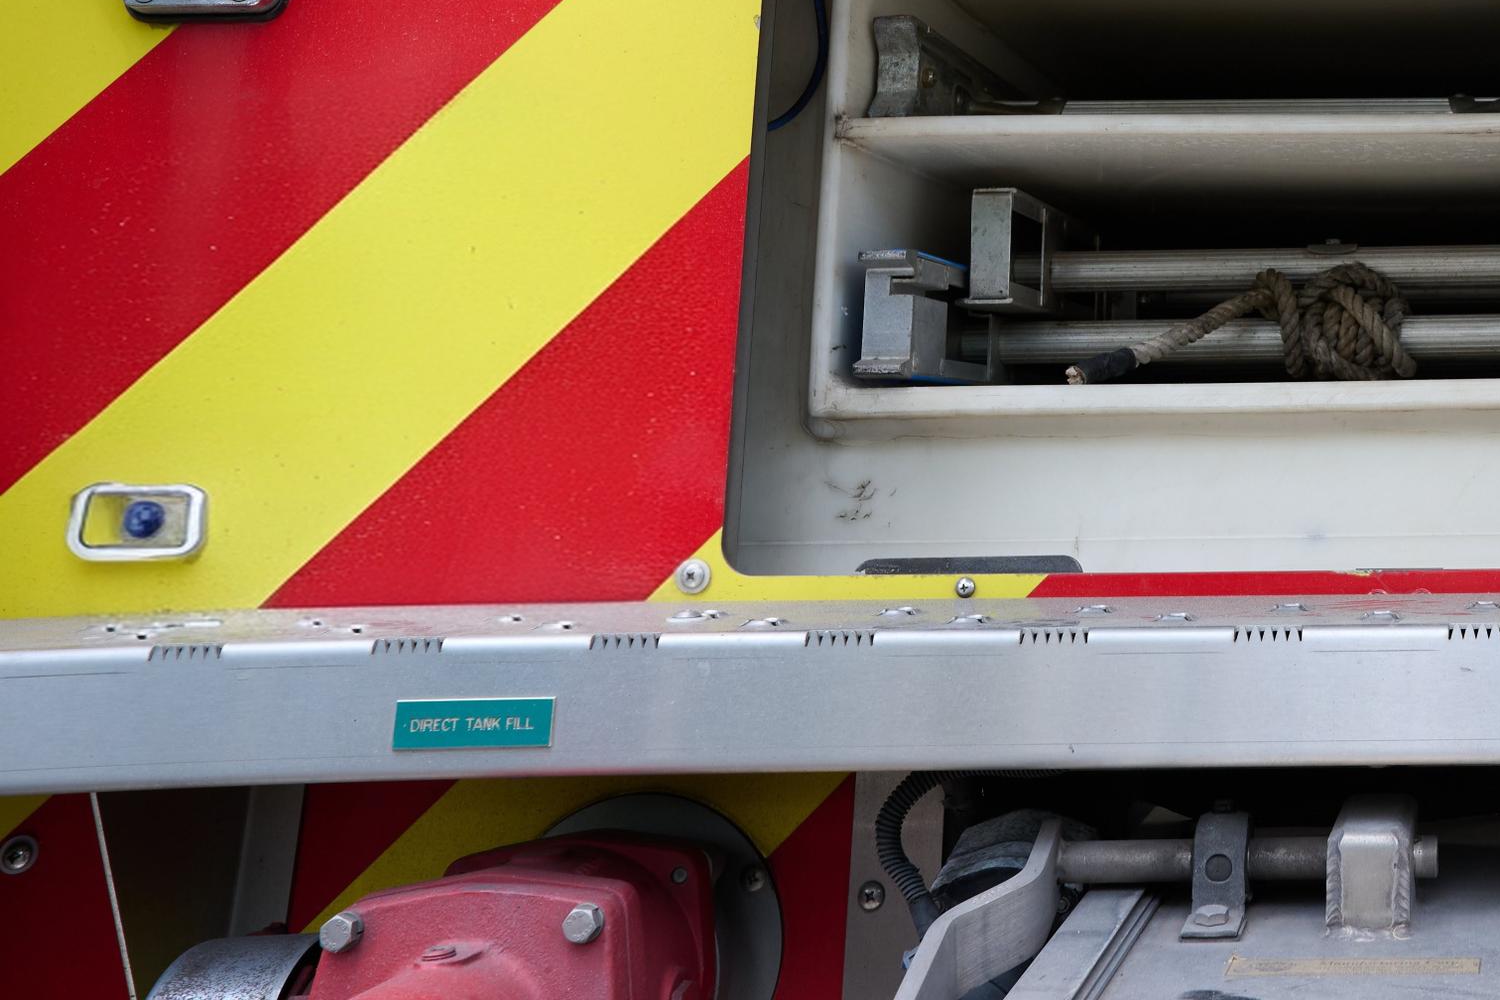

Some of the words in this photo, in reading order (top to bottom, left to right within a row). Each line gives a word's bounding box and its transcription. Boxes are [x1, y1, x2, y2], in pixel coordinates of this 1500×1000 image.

[410, 718, 460, 733] DIRECT
[466, 717, 501, 731] TANK
[505, 716, 535, 730] FILL
